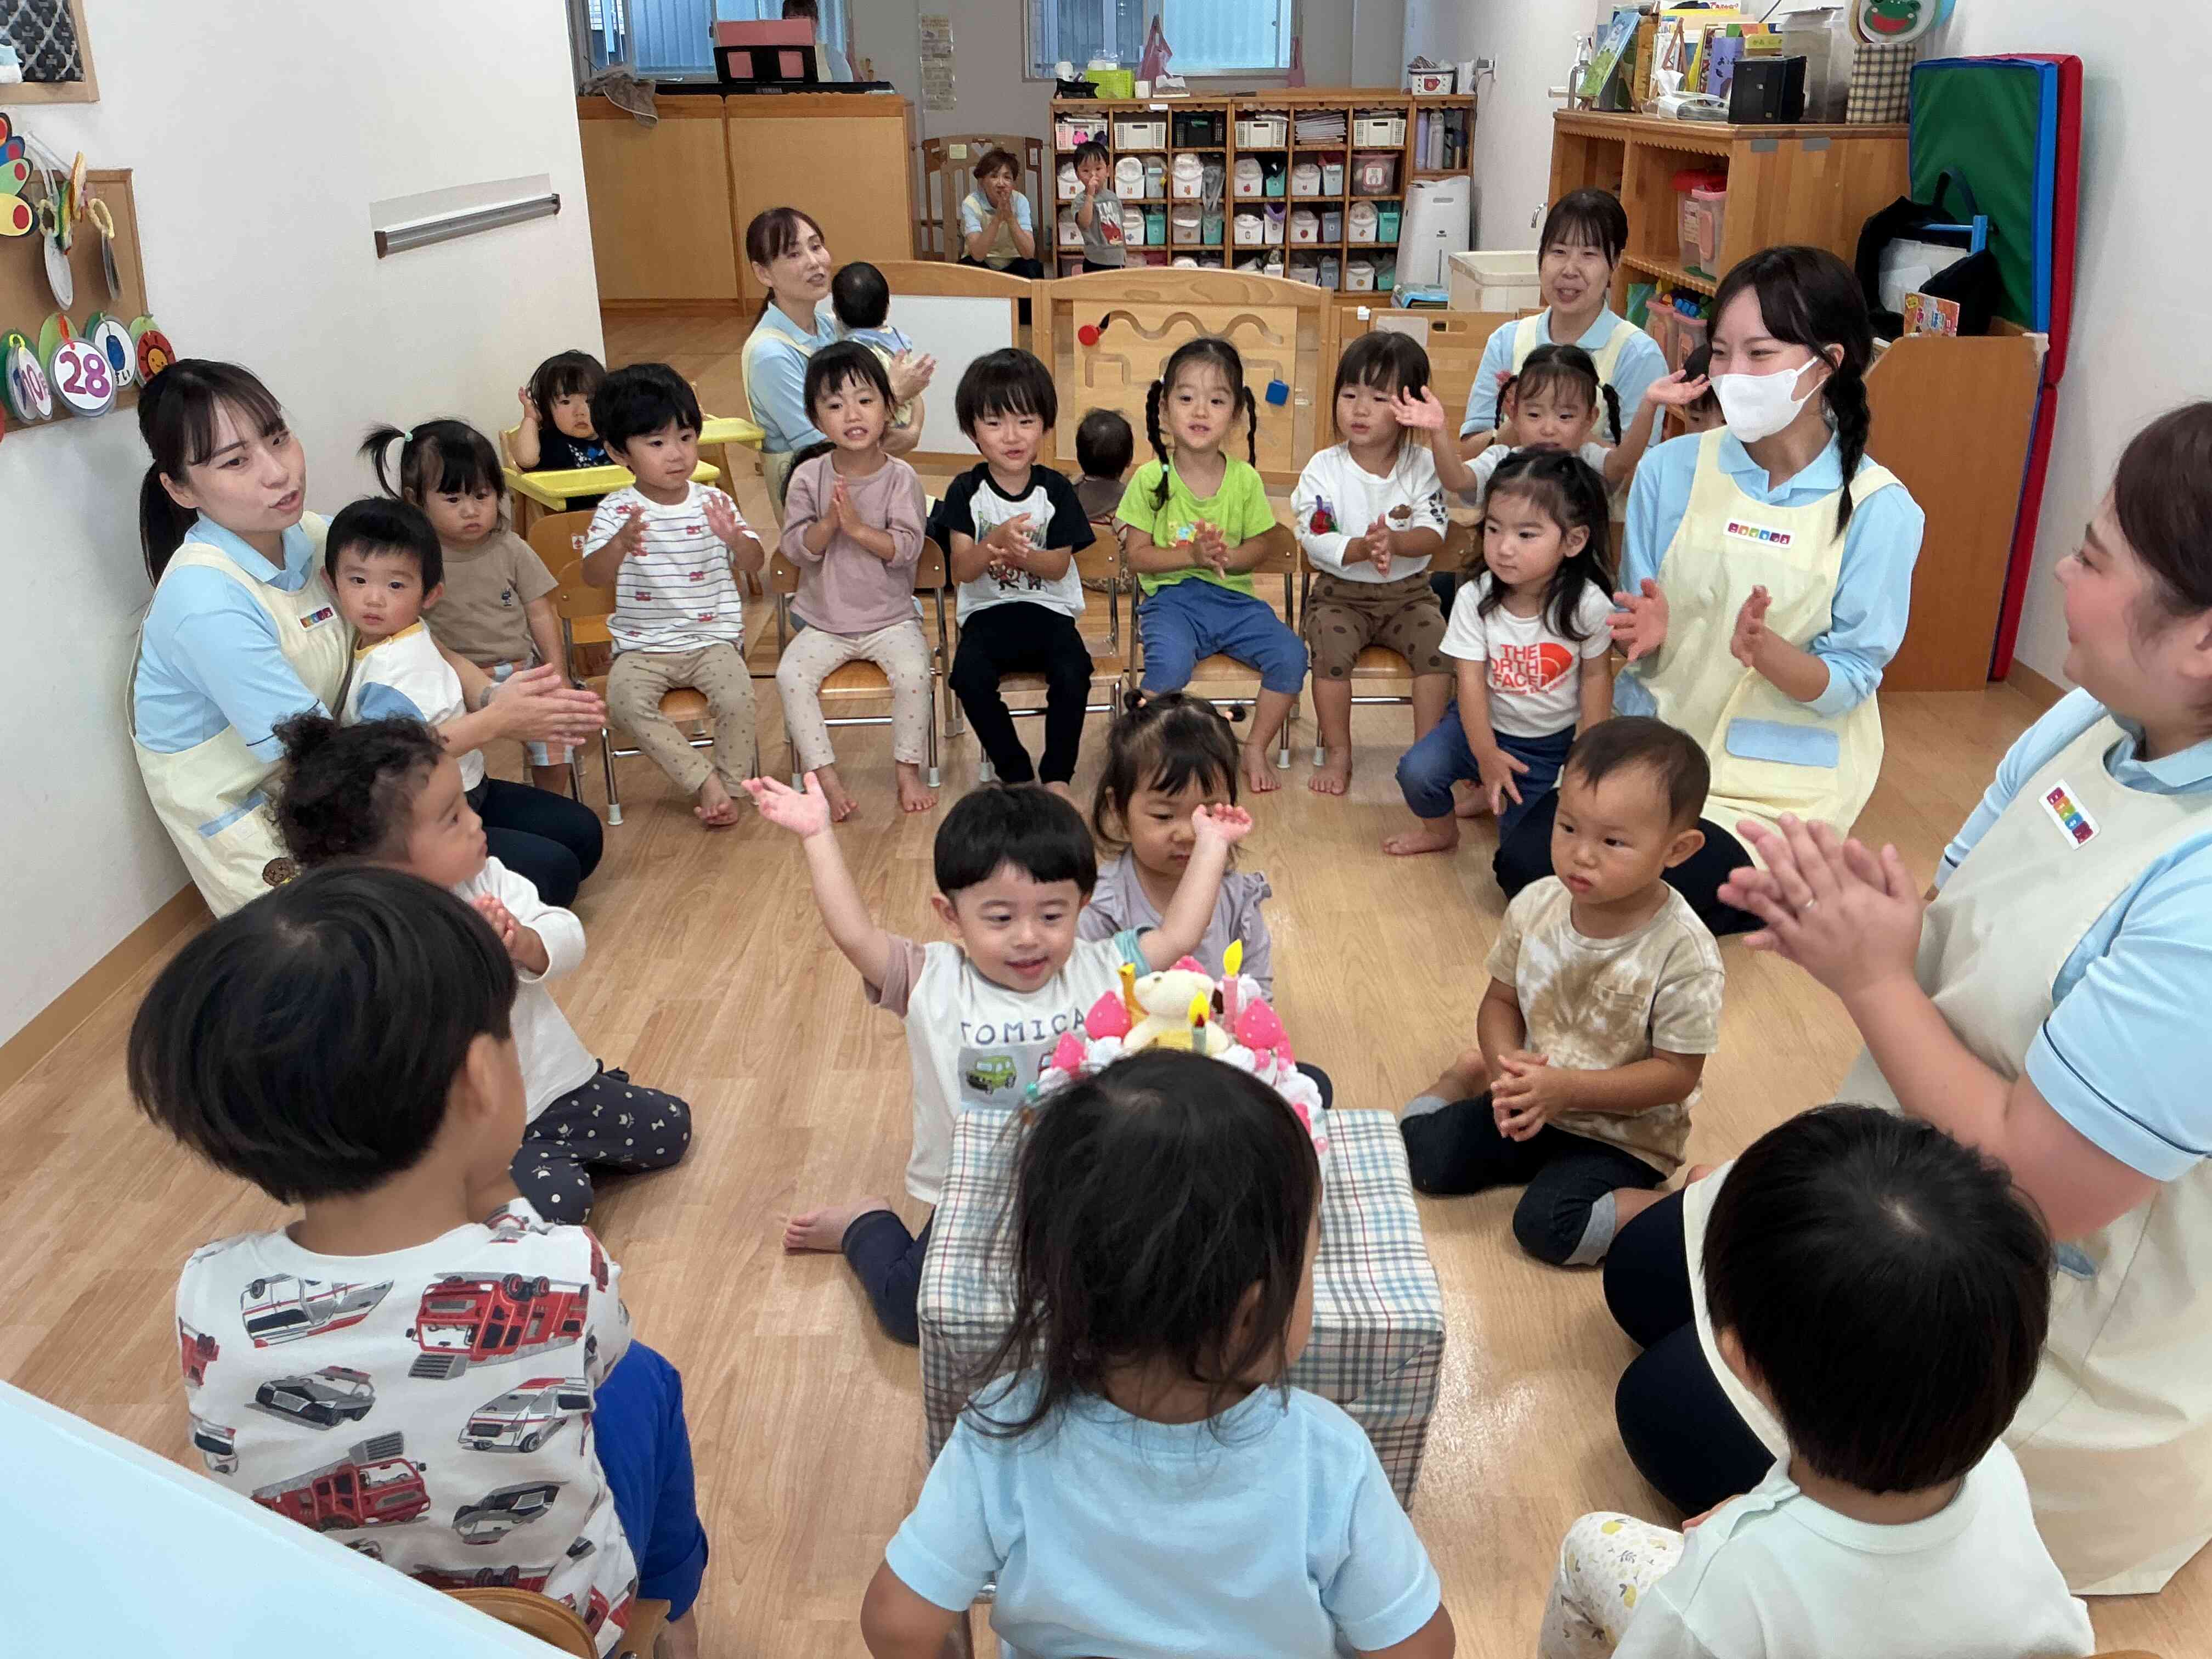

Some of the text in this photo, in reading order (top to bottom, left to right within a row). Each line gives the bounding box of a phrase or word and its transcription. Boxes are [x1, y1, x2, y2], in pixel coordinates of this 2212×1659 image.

[59, 351, 111, 398] 28
[1500, 643, 1538, 660] THE
[1491, 658, 1539, 675] ORTH
[1492, 673, 1538, 688] FACE
[961, 1007, 1085, 1045] TOMICA
